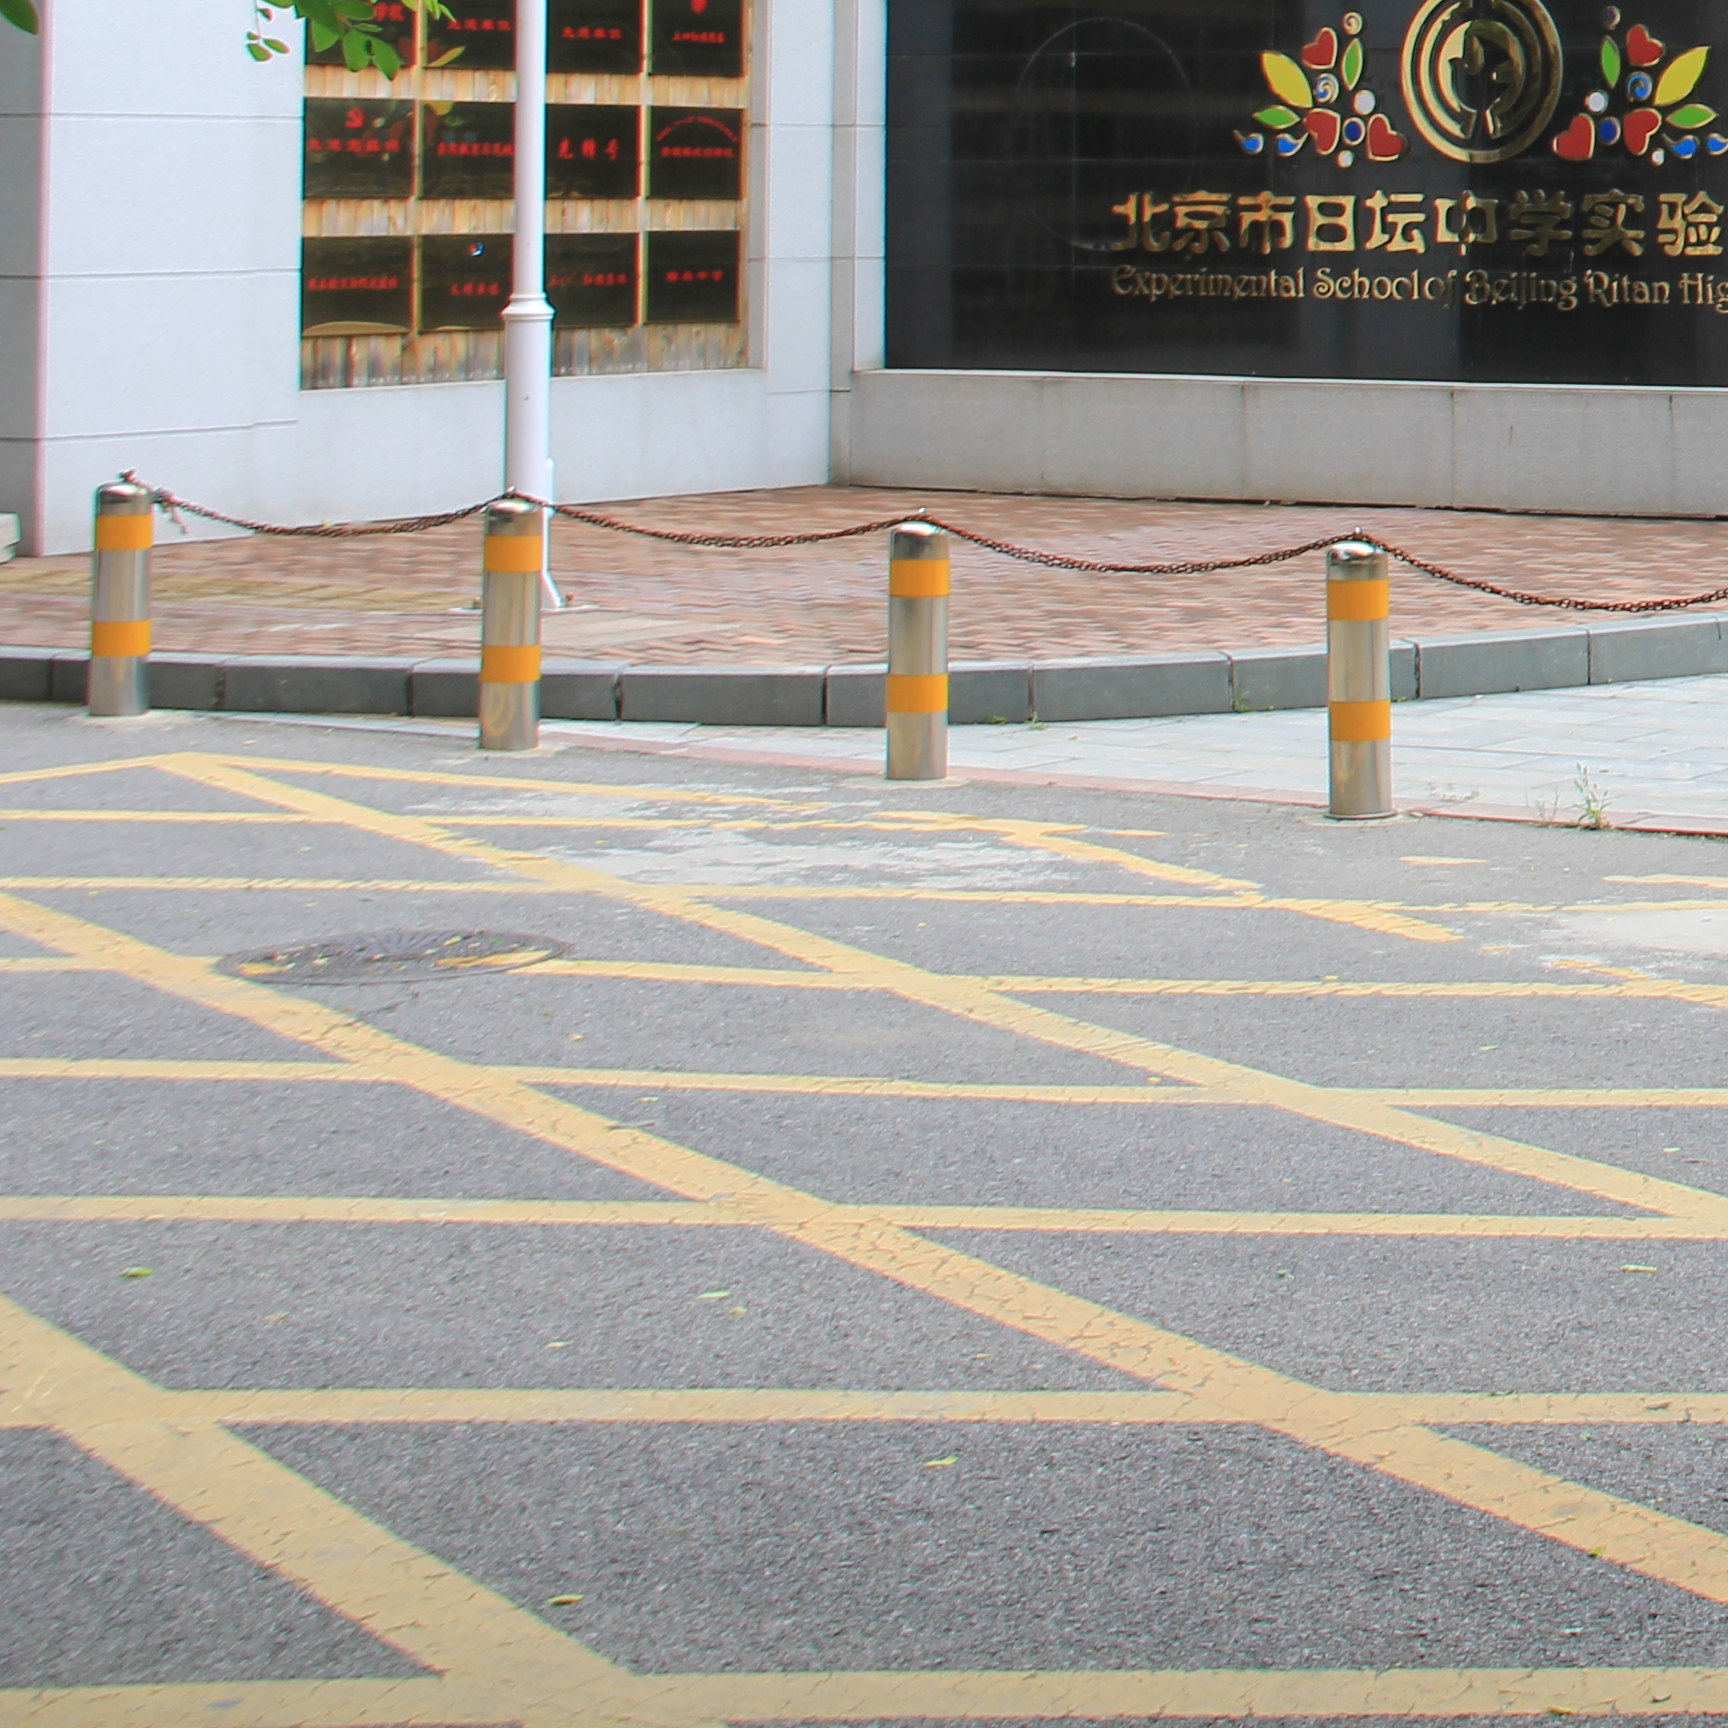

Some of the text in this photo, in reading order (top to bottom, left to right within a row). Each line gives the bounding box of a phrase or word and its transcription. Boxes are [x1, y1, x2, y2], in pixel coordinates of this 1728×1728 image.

[1111, 265, 1305, 302] Experimental
[1464, 269, 1578, 311] Beijing
[1583, 269, 1671, 307] Ritan
